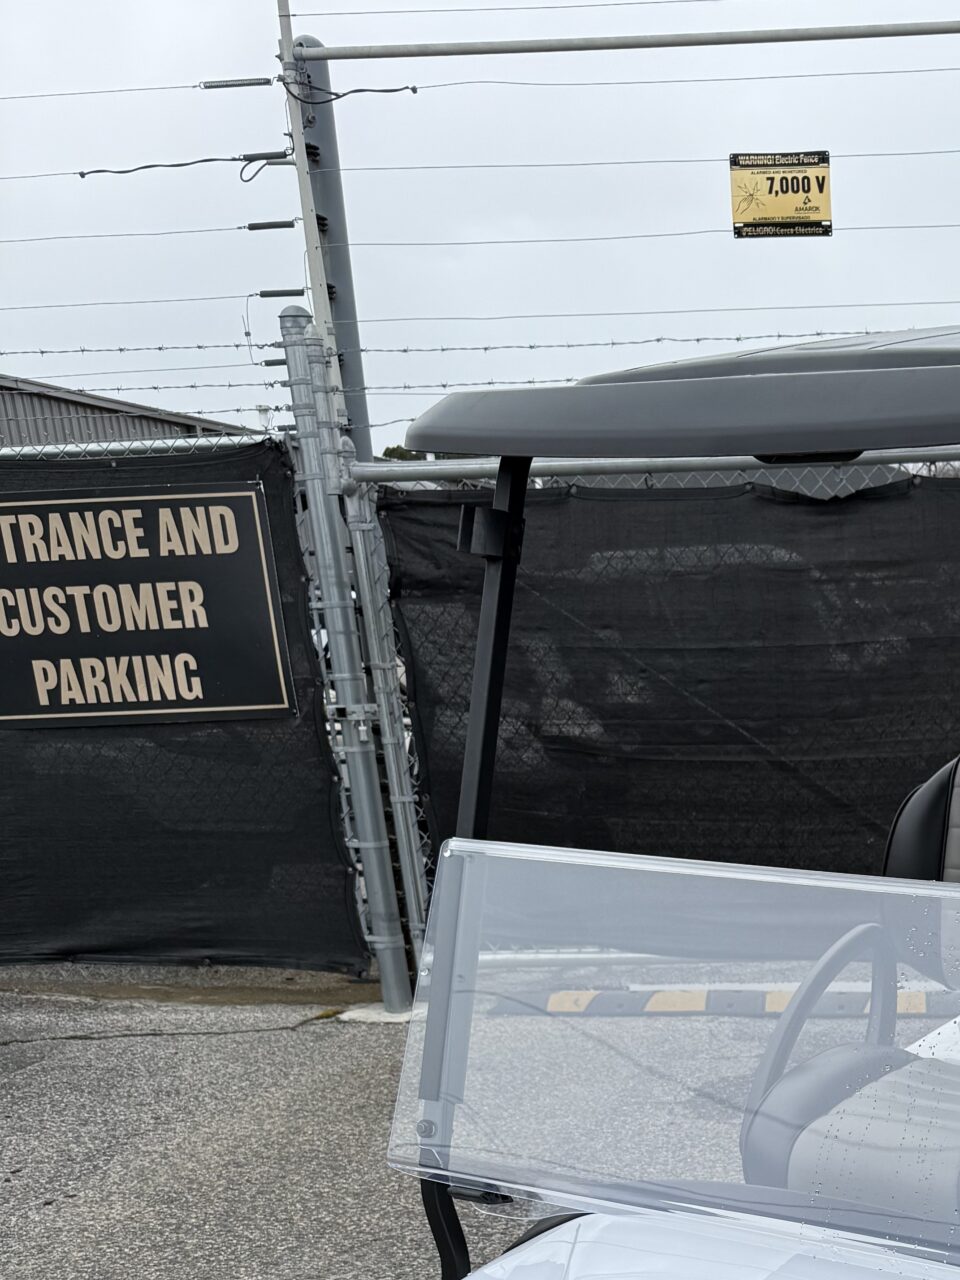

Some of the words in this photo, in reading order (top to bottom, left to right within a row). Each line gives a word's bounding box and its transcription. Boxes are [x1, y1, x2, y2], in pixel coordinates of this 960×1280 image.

[738, 155, 774, 165] WARNING!
[775, 155, 798, 164] Electric
[800, 154, 819, 163] Fence
[766, 176, 811, 197] 7,000
[815, 176, 826, 194] V
[158, 505, 239, 556] AND
[0, 581, 208, 637] CUSTOMER
[32, 653, 203, 706] PARKING
